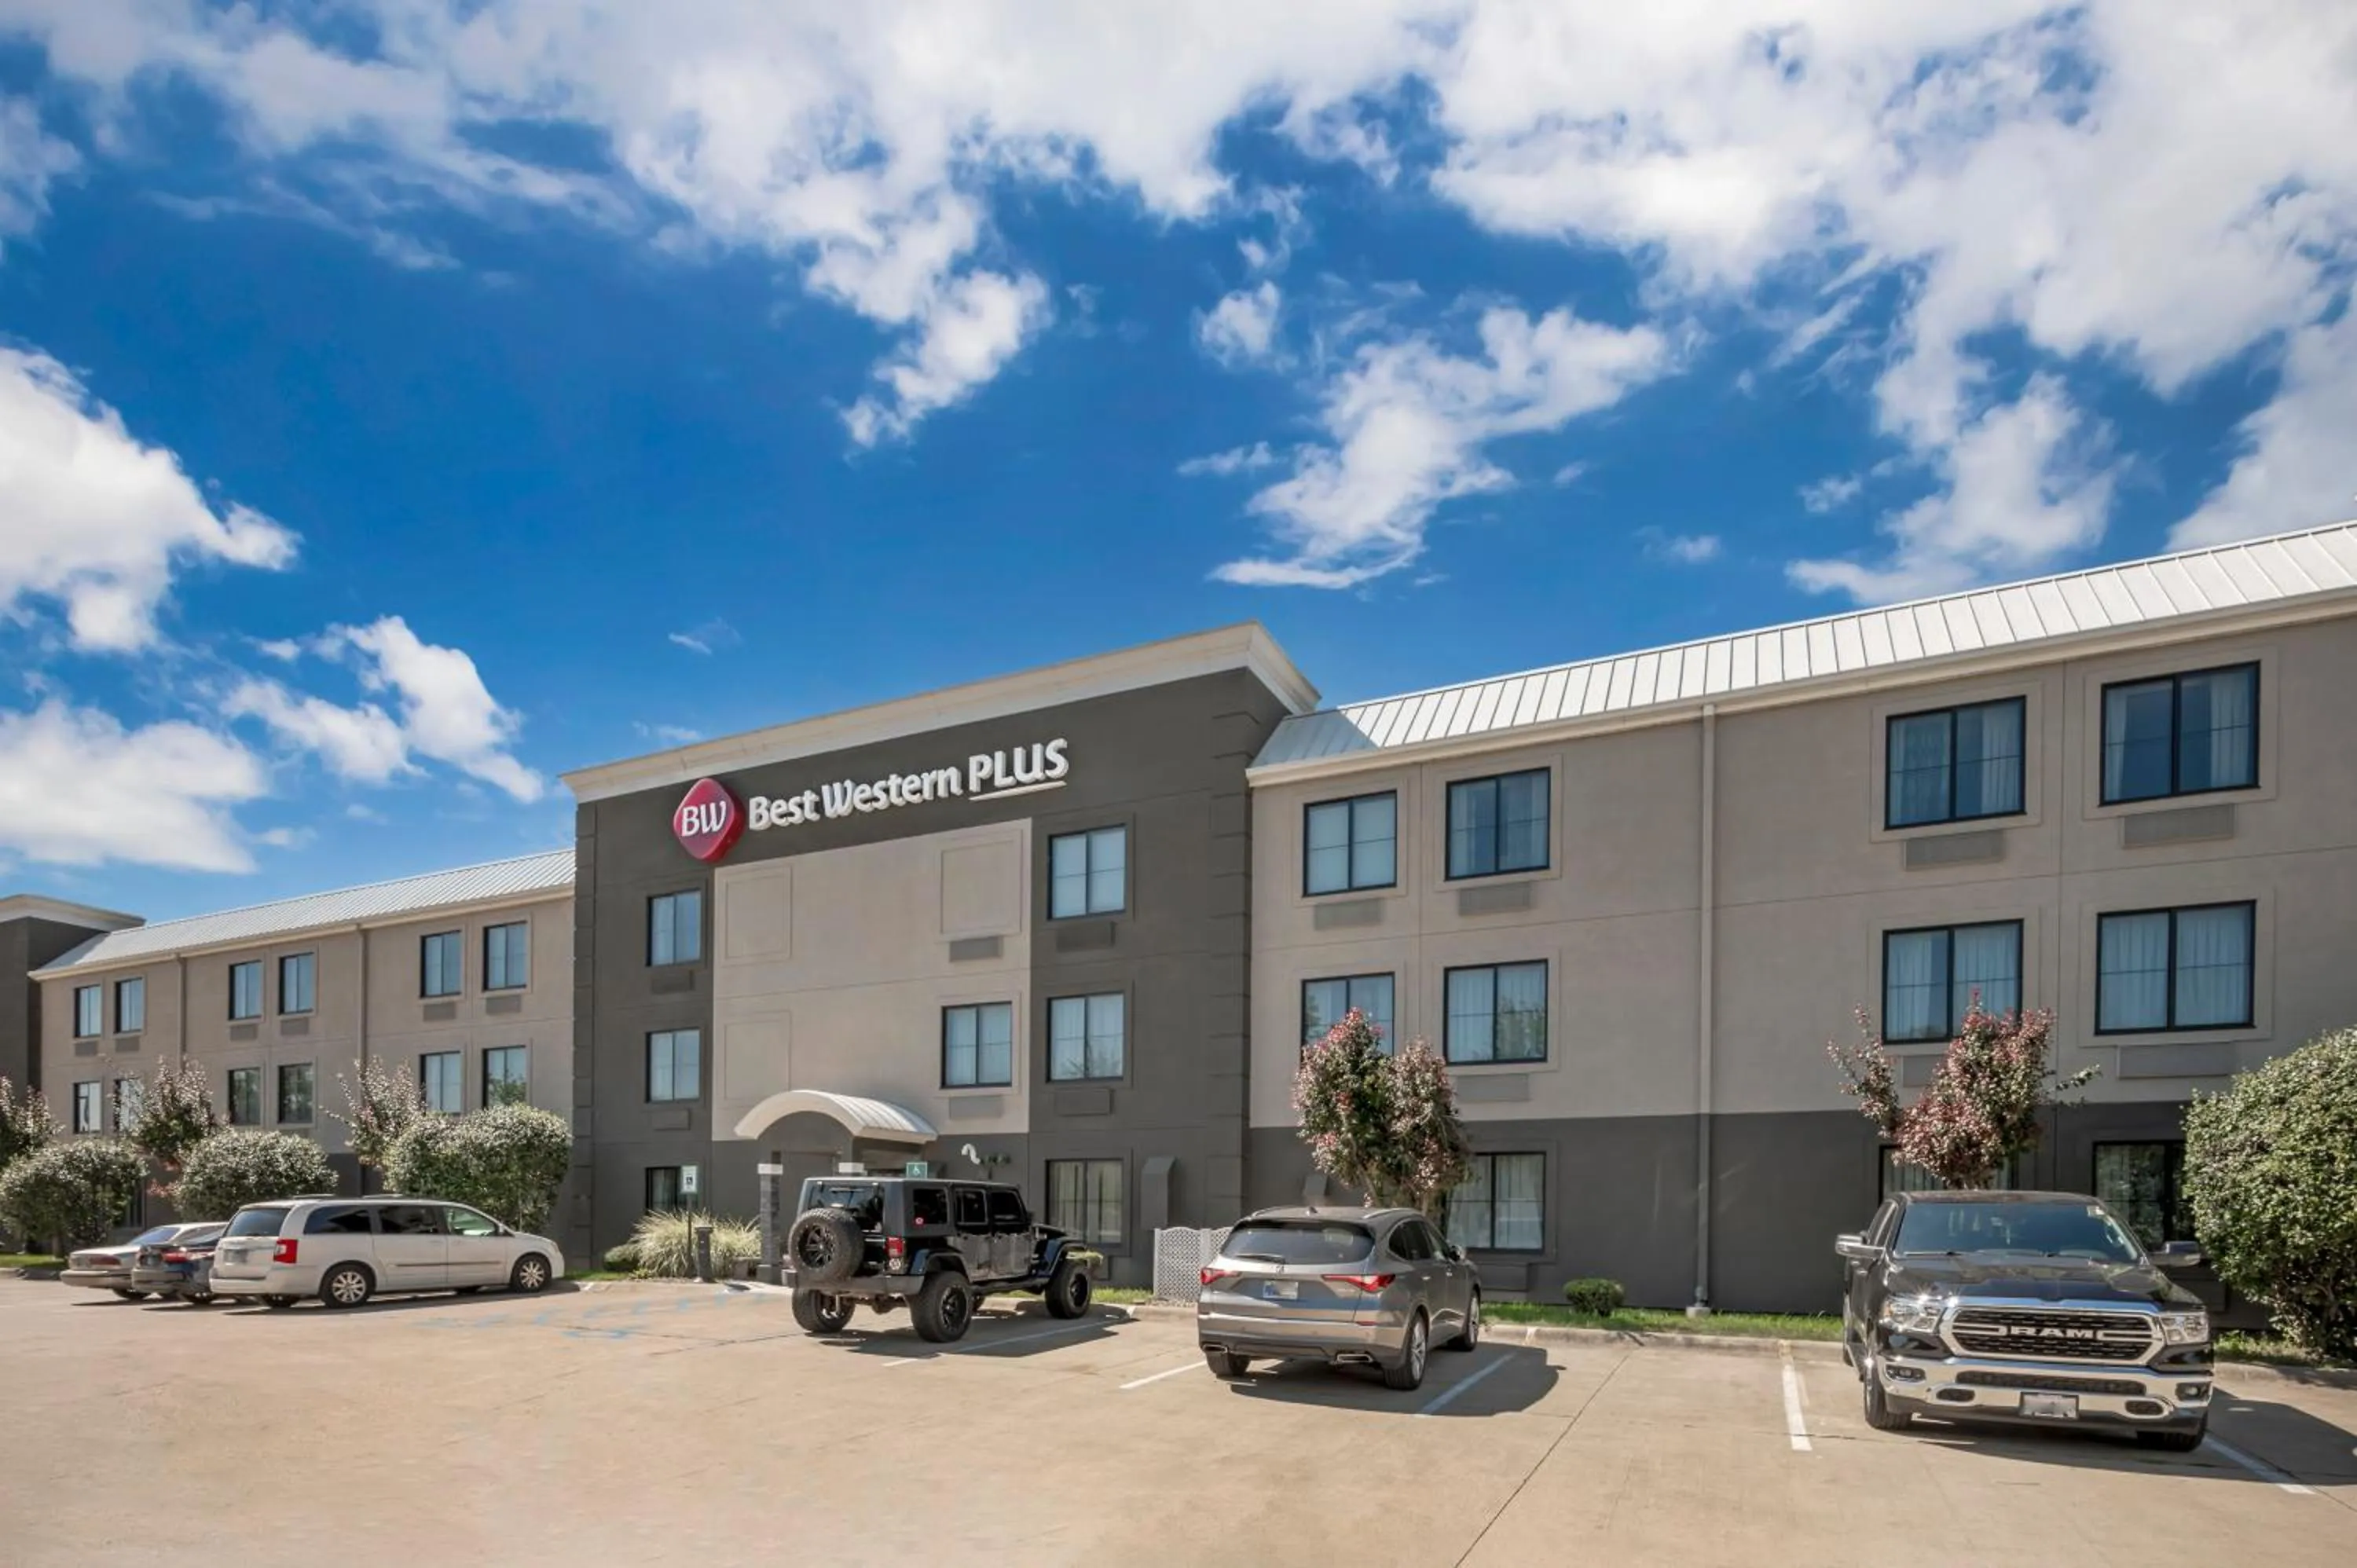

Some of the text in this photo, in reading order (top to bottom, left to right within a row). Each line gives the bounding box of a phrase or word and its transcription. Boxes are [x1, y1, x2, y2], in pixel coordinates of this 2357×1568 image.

[749, 738, 1069, 830] Best Western PLUS
[681, 800, 727, 837] BW
[2011, 1325, 2094, 1339] RAM
